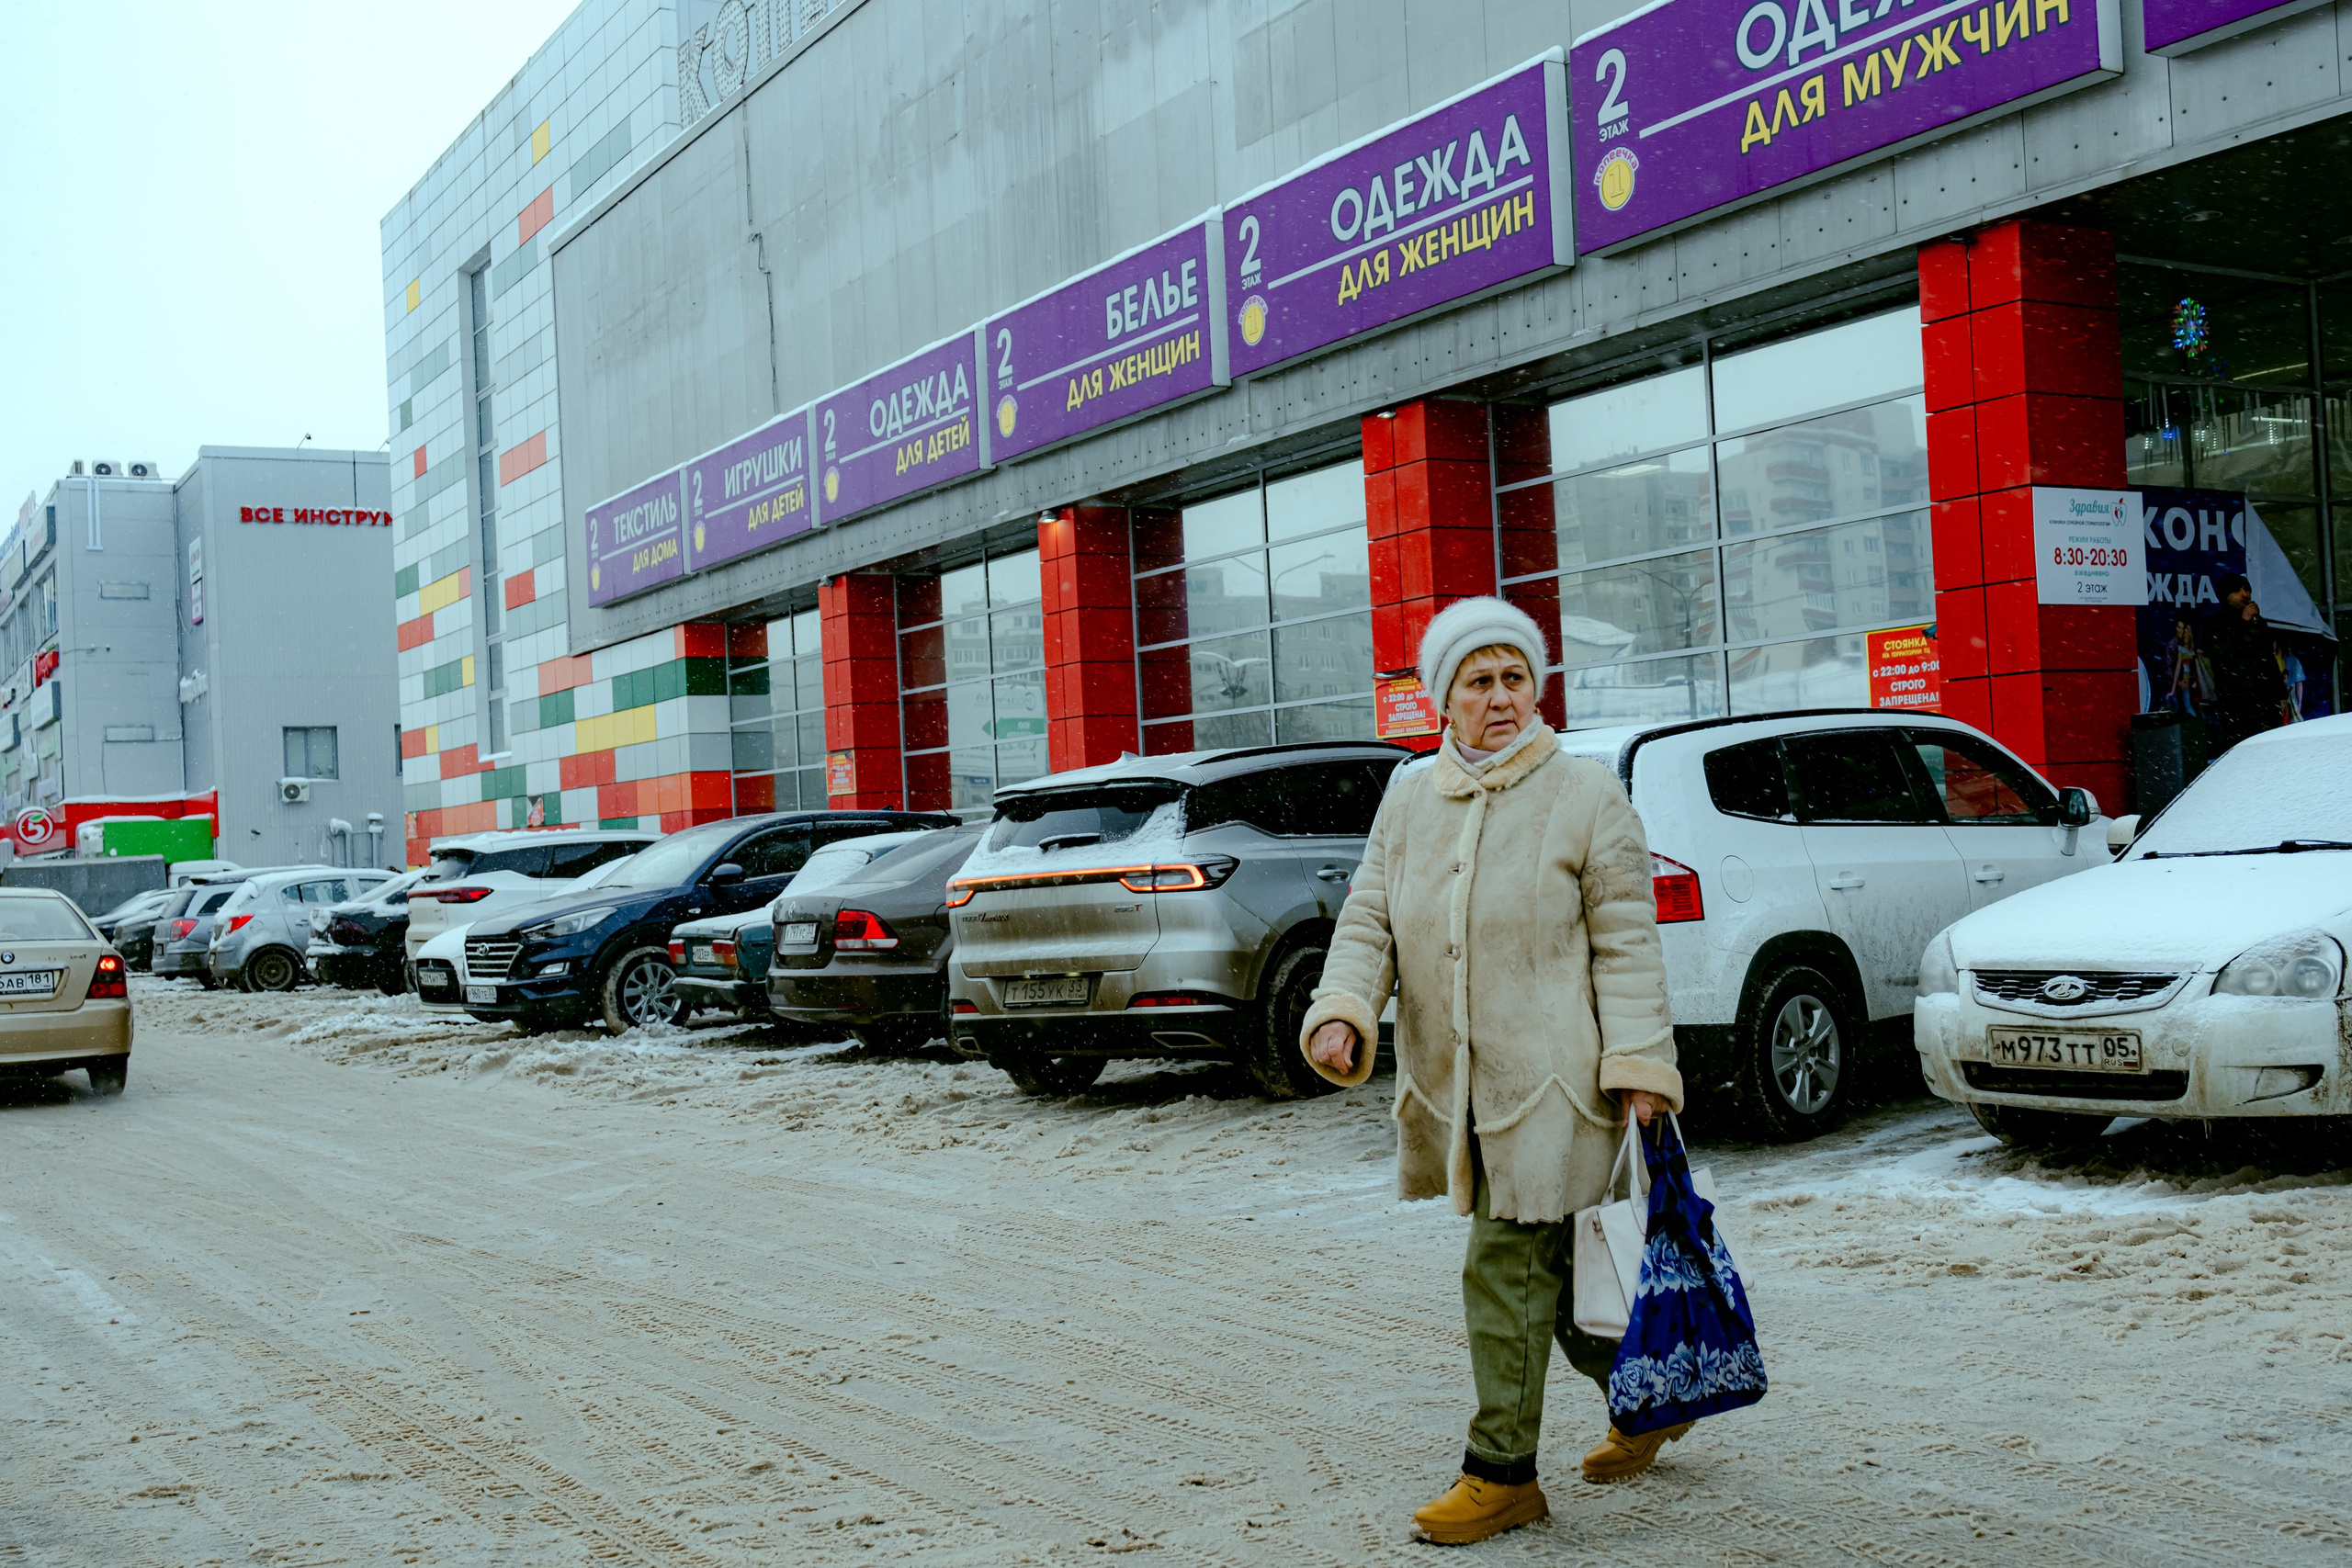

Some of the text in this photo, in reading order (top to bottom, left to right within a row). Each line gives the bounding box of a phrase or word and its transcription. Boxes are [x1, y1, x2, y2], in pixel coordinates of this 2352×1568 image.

[1596, 48, 1629, 127] 2
[1741, 0, 2069, 154] ДЛЯ МУЖЧИН
[1599, 118, 1630, 143] ЭТАЖ
[1331, 114, 1532, 242] ОДЕЖДА
[1595, 149, 1638, 184] копеечка
[1238, 215, 1261, 276] 2
[1338, 190, 1534, 306] ДЛЯ ЖЕНЩИН
[1241, 272, 1261, 290] ЭТАЖ
[1106, 257, 1198, 340] БЕЛЬЕ
[996, 327, 1013, 379] 2
[1066, 367, 1102, 412] ДЛЯ
[1108, 329, 1201, 392] ЖЕНЩИН
[869, 363, 969, 439] ОДЕЖДА
[823, 409, 836, 453] 2
[896, 415, 970, 476] ДЛЯ ДЕТЕЙ
[724, 435, 803, 500] ИГРУШКИ
[693, 470, 703, 508] 2
[240, 506, 284, 524] ВСЕ
[613, 492, 677, 545] ТЕКСТИЛЬ
[747, 482, 804, 532] ДЛЯ ДЕТЕЙ
[2069, 498, 2109, 517] Здравия
[590, 517, 598, 551] 2
[632, 537, 678, 575] ДЛЯ ДОМА
[2054, 547, 2127, 567] 8:30-20:30
[2077, 581, 2108, 592] 2 этаж
[1883, 637, 1928, 651] СТОЯНКА
[1891, 649, 1922, 658] ТЕРРИТОРИИ
[1880, 664, 1906, 677] 22:00
[1890, 678, 1926, 693] СТРОГО
[1388, 693, 1405, 703] 22:00
[1395, 701, 1418, 712] СТРОГО
[1879, 691, 1939, 707] ЗАПРЕЩЕНА!
[1388, 709, 1426, 722] ЗАПРЕЩЕНА!
[28, 974, 50, 984] 181
[2103, 1037, 2130, 1057] 05
[2104, 1058, 2123, 1066] RUS
